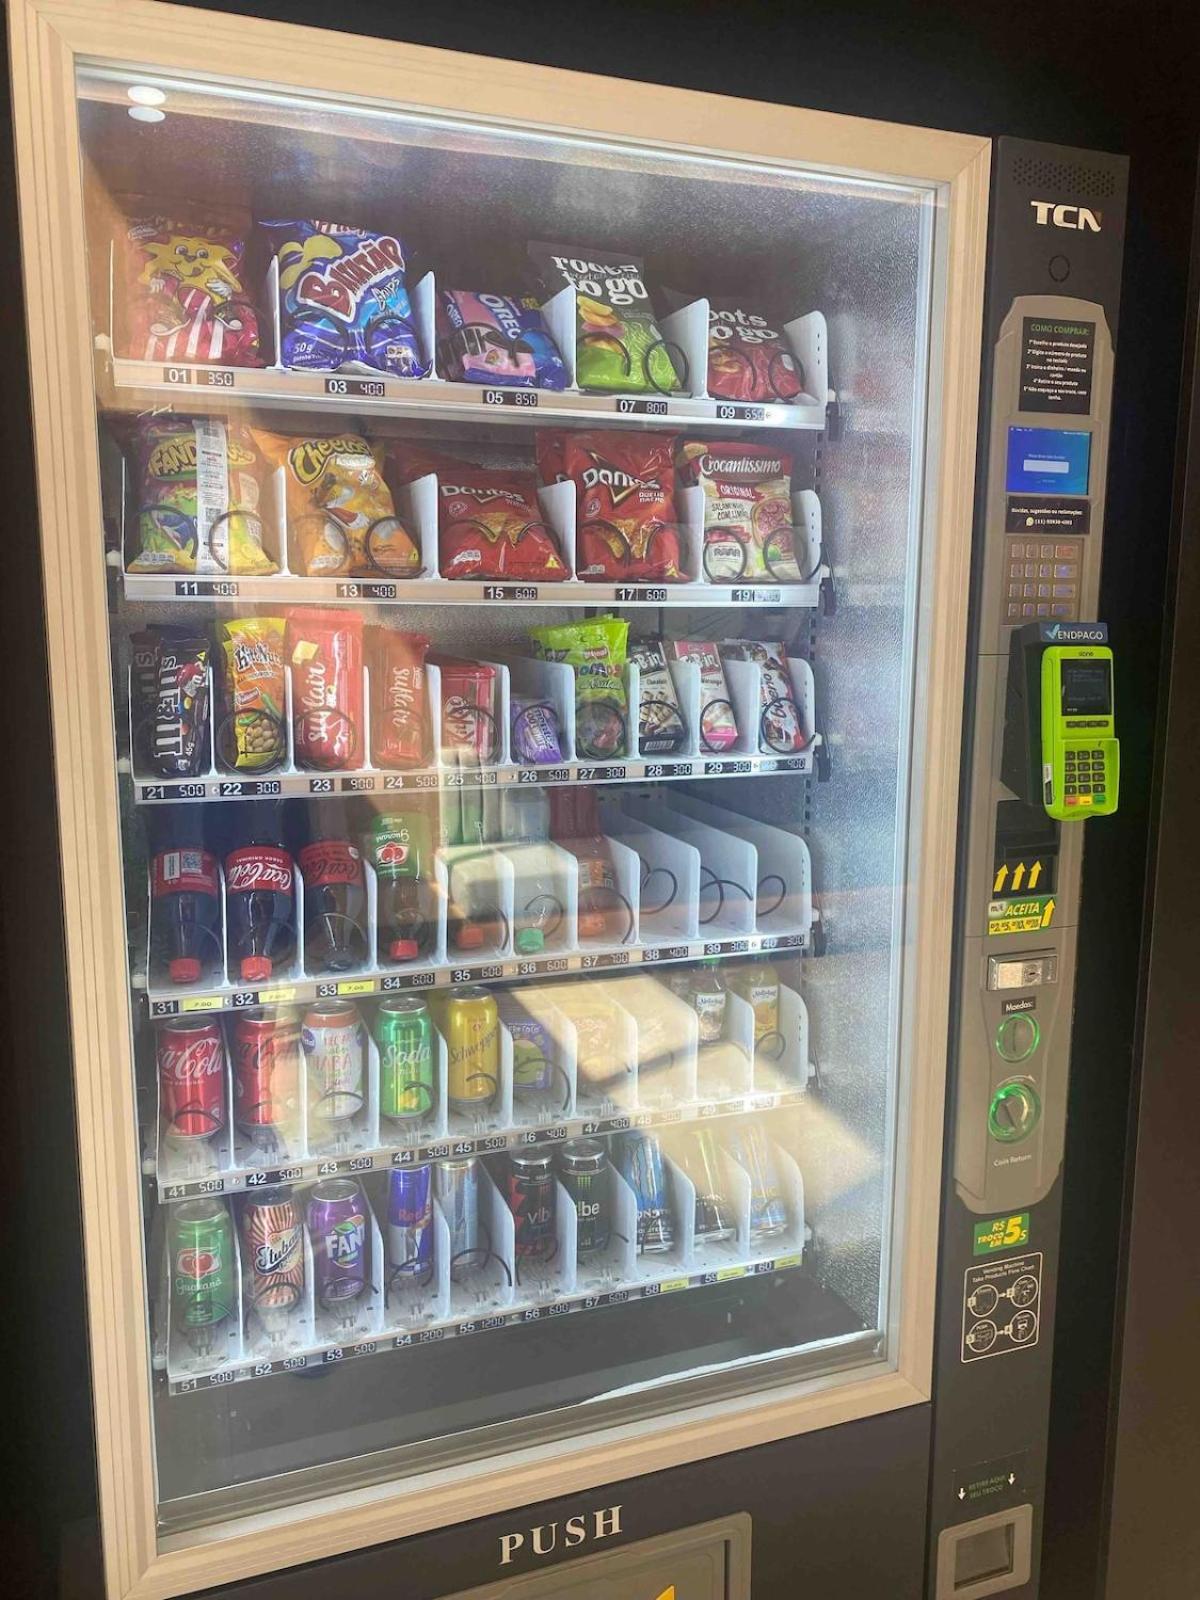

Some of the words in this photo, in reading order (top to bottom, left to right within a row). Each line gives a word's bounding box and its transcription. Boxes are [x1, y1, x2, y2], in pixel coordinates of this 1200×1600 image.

[1030, 201, 1101, 232] TCN
[605, 276, 649, 305] go
[707, 309, 767, 327] oots
[709, 325, 733, 340] o
[738, 327, 779, 344] go
[168, 369, 187, 383] 01
[329, 380, 347, 394] 03
[486, 391, 503, 404] 05
[620, 401, 636, 413] 07
[720, 407, 735, 418] 09
[180, 582, 199, 595] 11
[212, 584, 238, 595] 400
[340, 585, 358, 597] 13
[487, 587, 504, 599] 15
[619, 589, 634, 600] 17
[736, 590, 750, 601] 19
[580, 768, 595, 779] 27
[648, 765, 662, 776] 28
[708, 763, 723, 773] 29
[386, 776, 404, 789] 24
[447, 774, 464, 786] 25
[521, 771, 537, 783] 26
[223, 783, 243, 796] 22
[312, 779, 331, 791] 23
[146, 787, 165, 799] 21
[179, 785, 205, 797] 500
[1005, 902, 1040, 917] ACEITA
[707, 943, 721, 954] 39
[584, 955, 599, 967] 37
[644, 949, 660, 961] 38
[520, 962, 537, 974] 36
[454, 970, 471, 982] 35
[320, 984, 337, 996] 33
[384, 978, 401, 990] 34
[235, 993, 255, 1005] 32
[156, 1002, 175, 1014] 31
[585, 1122, 600, 1133] 47
[456, 1142, 472, 1153] 45
[394, 1151, 411, 1163] 44
[1010, 1154, 1032, 1164] Return
[321, 1162, 338, 1174] 43
[350, 1157, 372, 1169] 500
[248, 1173, 267, 1185] 42
[279, 1168, 302, 1180] 500
[168, 1186, 186, 1198] 41
[198, 1180, 223, 1193] 500
[645, 1284, 659, 1295] 58
[585, 1296, 600, 1307] 57
[525, 1308, 540, 1320] 56
[460, 1322, 475, 1334] 55
[396, 1335, 412, 1346] 54
[326, 1348, 343, 1361] 53
[255, 1362, 272, 1375] 52
[181, 1379, 198, 1392] 51
[499, 1505, 622, 1565] PUSH
